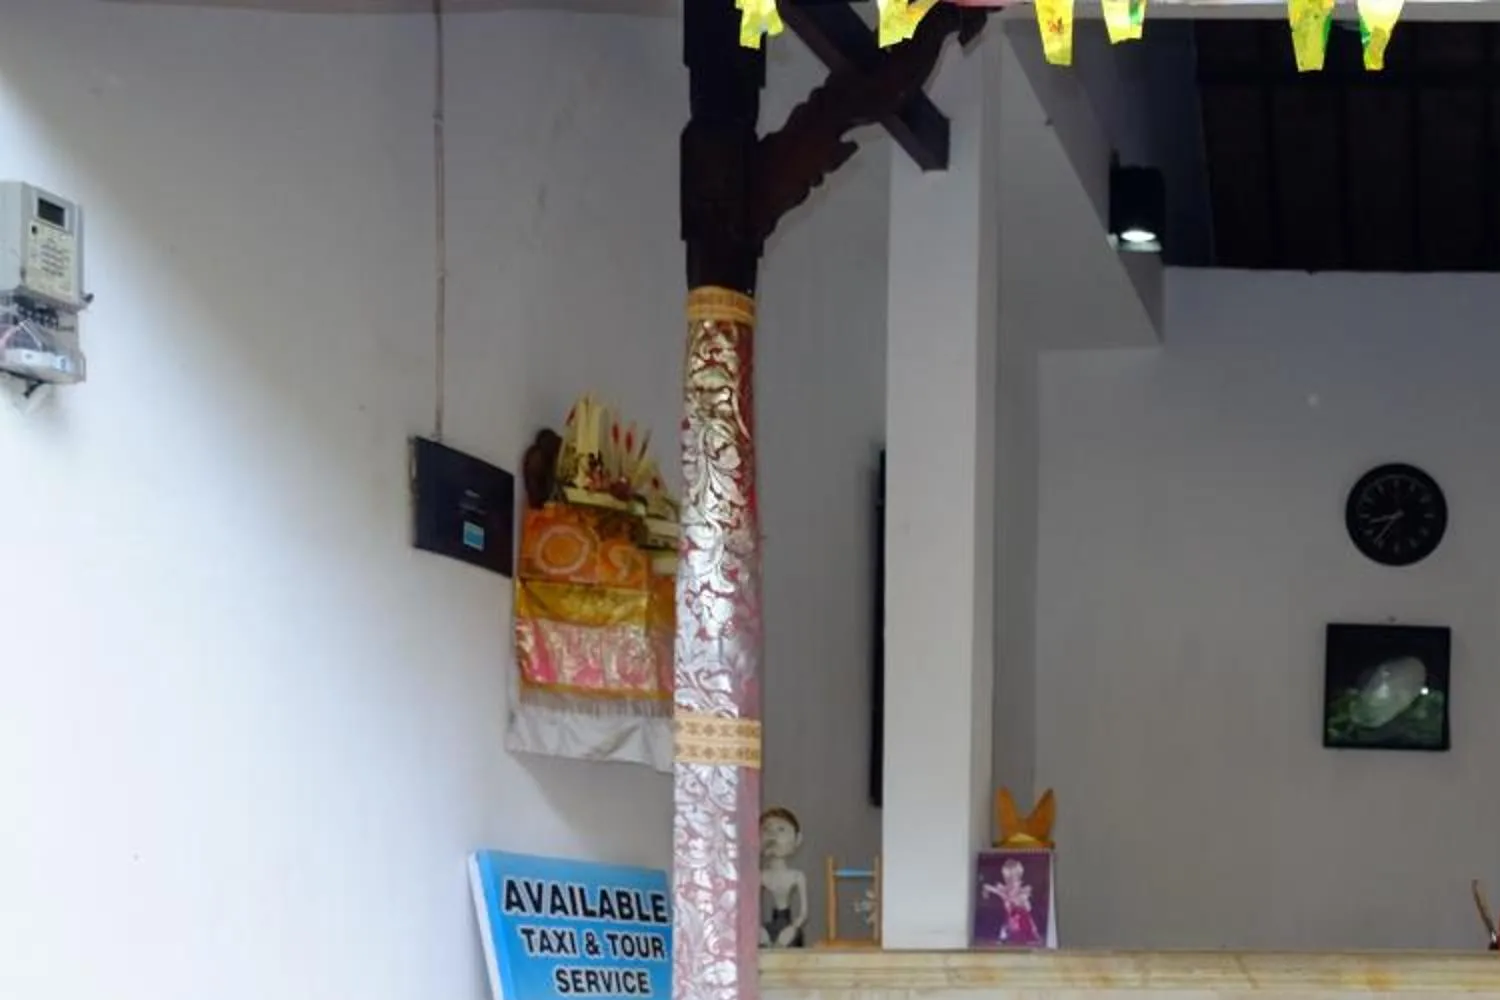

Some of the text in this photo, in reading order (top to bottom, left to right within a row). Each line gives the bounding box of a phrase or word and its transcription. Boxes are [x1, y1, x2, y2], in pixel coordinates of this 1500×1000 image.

[503, 878, 669, 924] AVAILABLE
[520, 927, 666, 960] TAXI & TOUR
[554, 967, 650, 994] SERVICE
